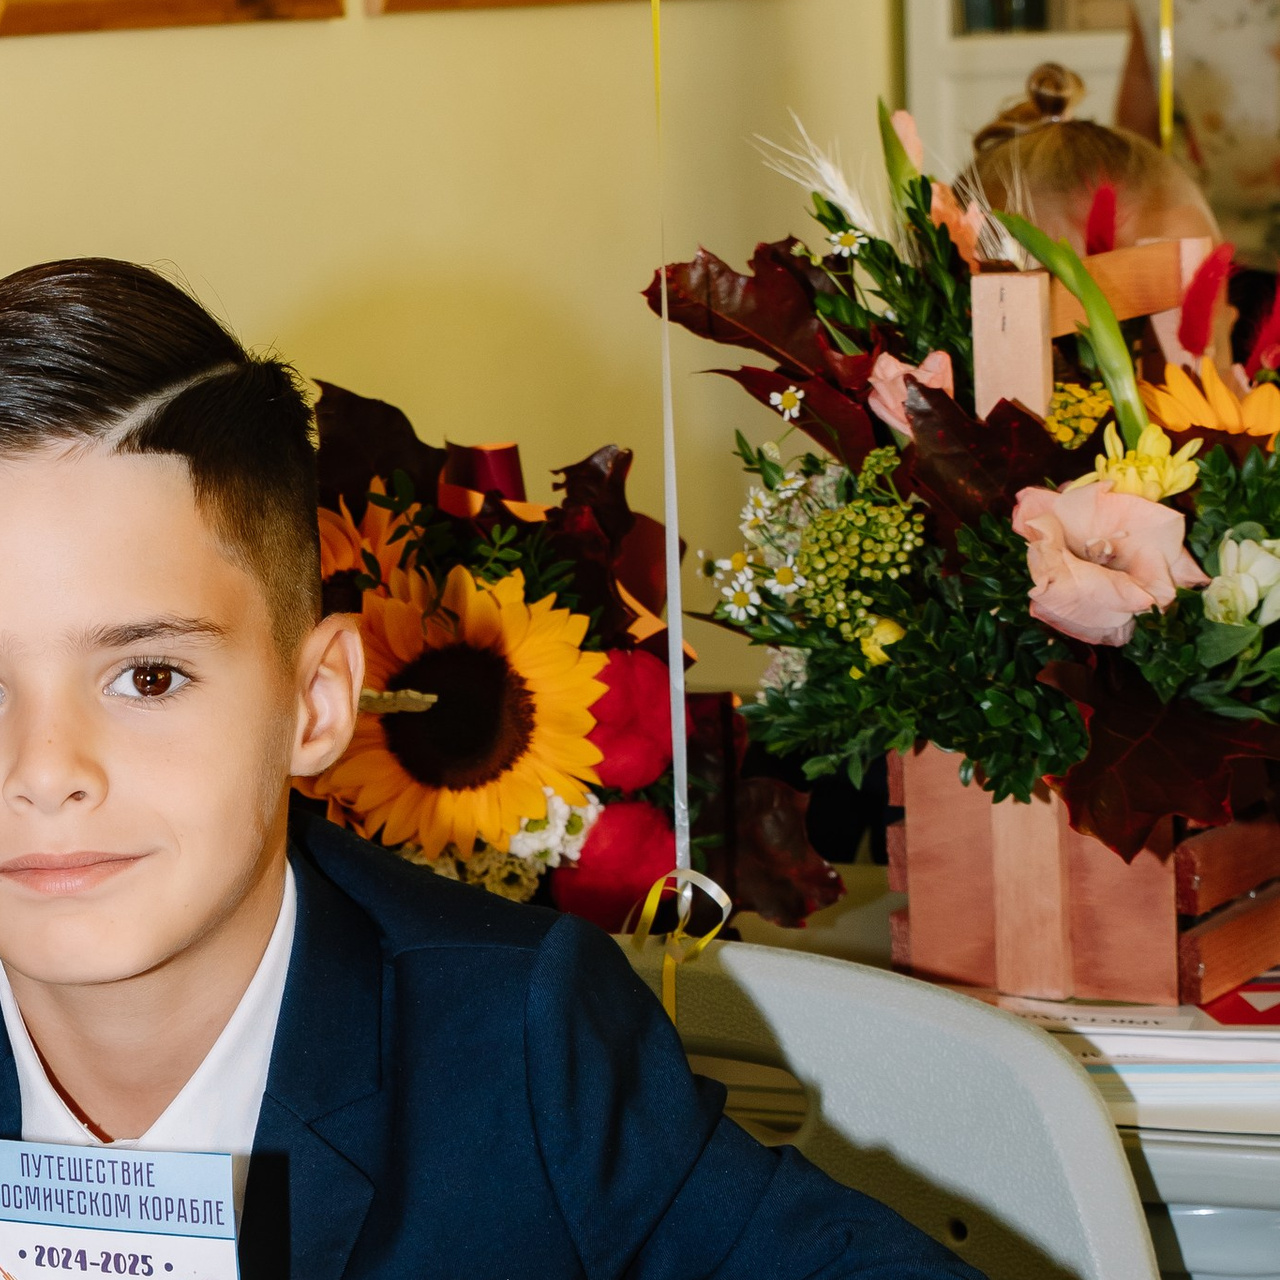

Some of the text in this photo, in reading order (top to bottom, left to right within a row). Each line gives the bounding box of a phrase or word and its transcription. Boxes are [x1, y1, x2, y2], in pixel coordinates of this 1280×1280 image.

[20, 1152, 155, 1187] ПУТЕШЕСТВИЕ
[139, 1195, 226, 1226] КОРАБЛЕ
[34, 1244, 155, 1277] 2024-2025
